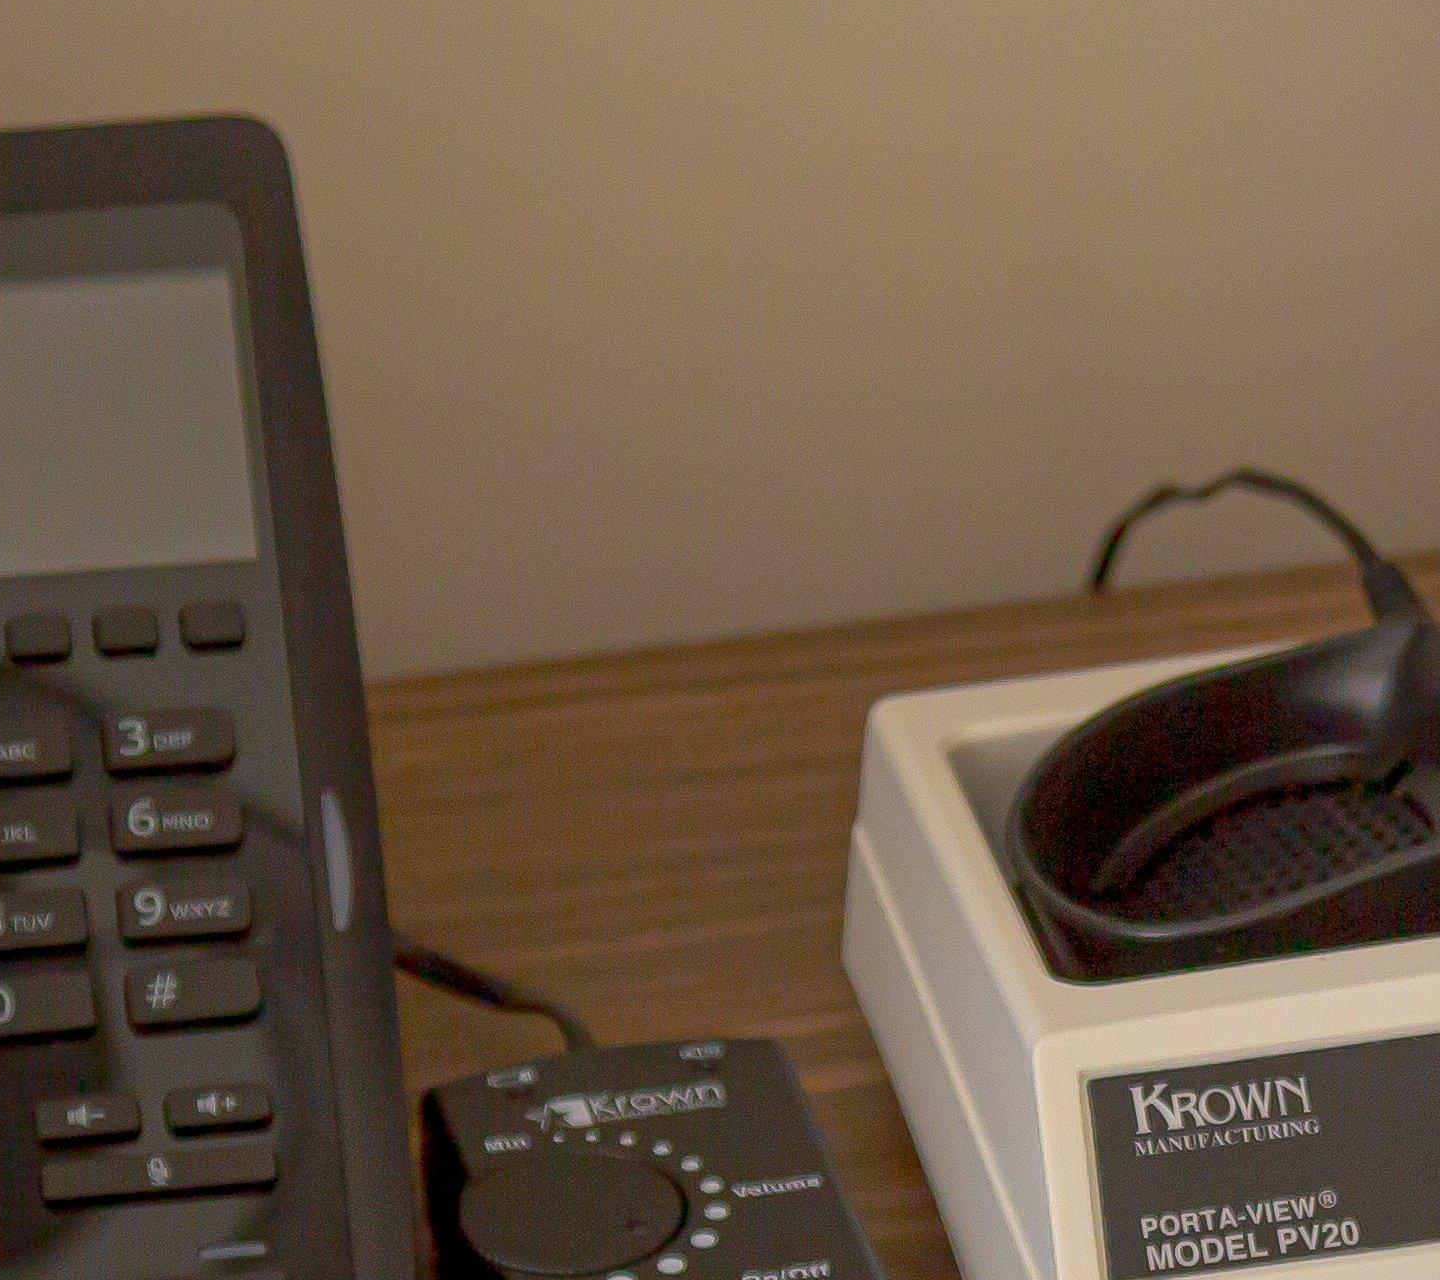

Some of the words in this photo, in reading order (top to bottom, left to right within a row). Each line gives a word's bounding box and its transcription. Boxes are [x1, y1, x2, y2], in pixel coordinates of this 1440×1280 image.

[118, 717, 148, 756] 3
[127, 797, 155, 836] 6
[133, 886, 162, 926] 9
[1135, 1120, 1320, 1157] MANUFACTURING
[1146, 1232, 1268, 1270] MODEL
[1276, 1221, 1359, 1254] PV20
